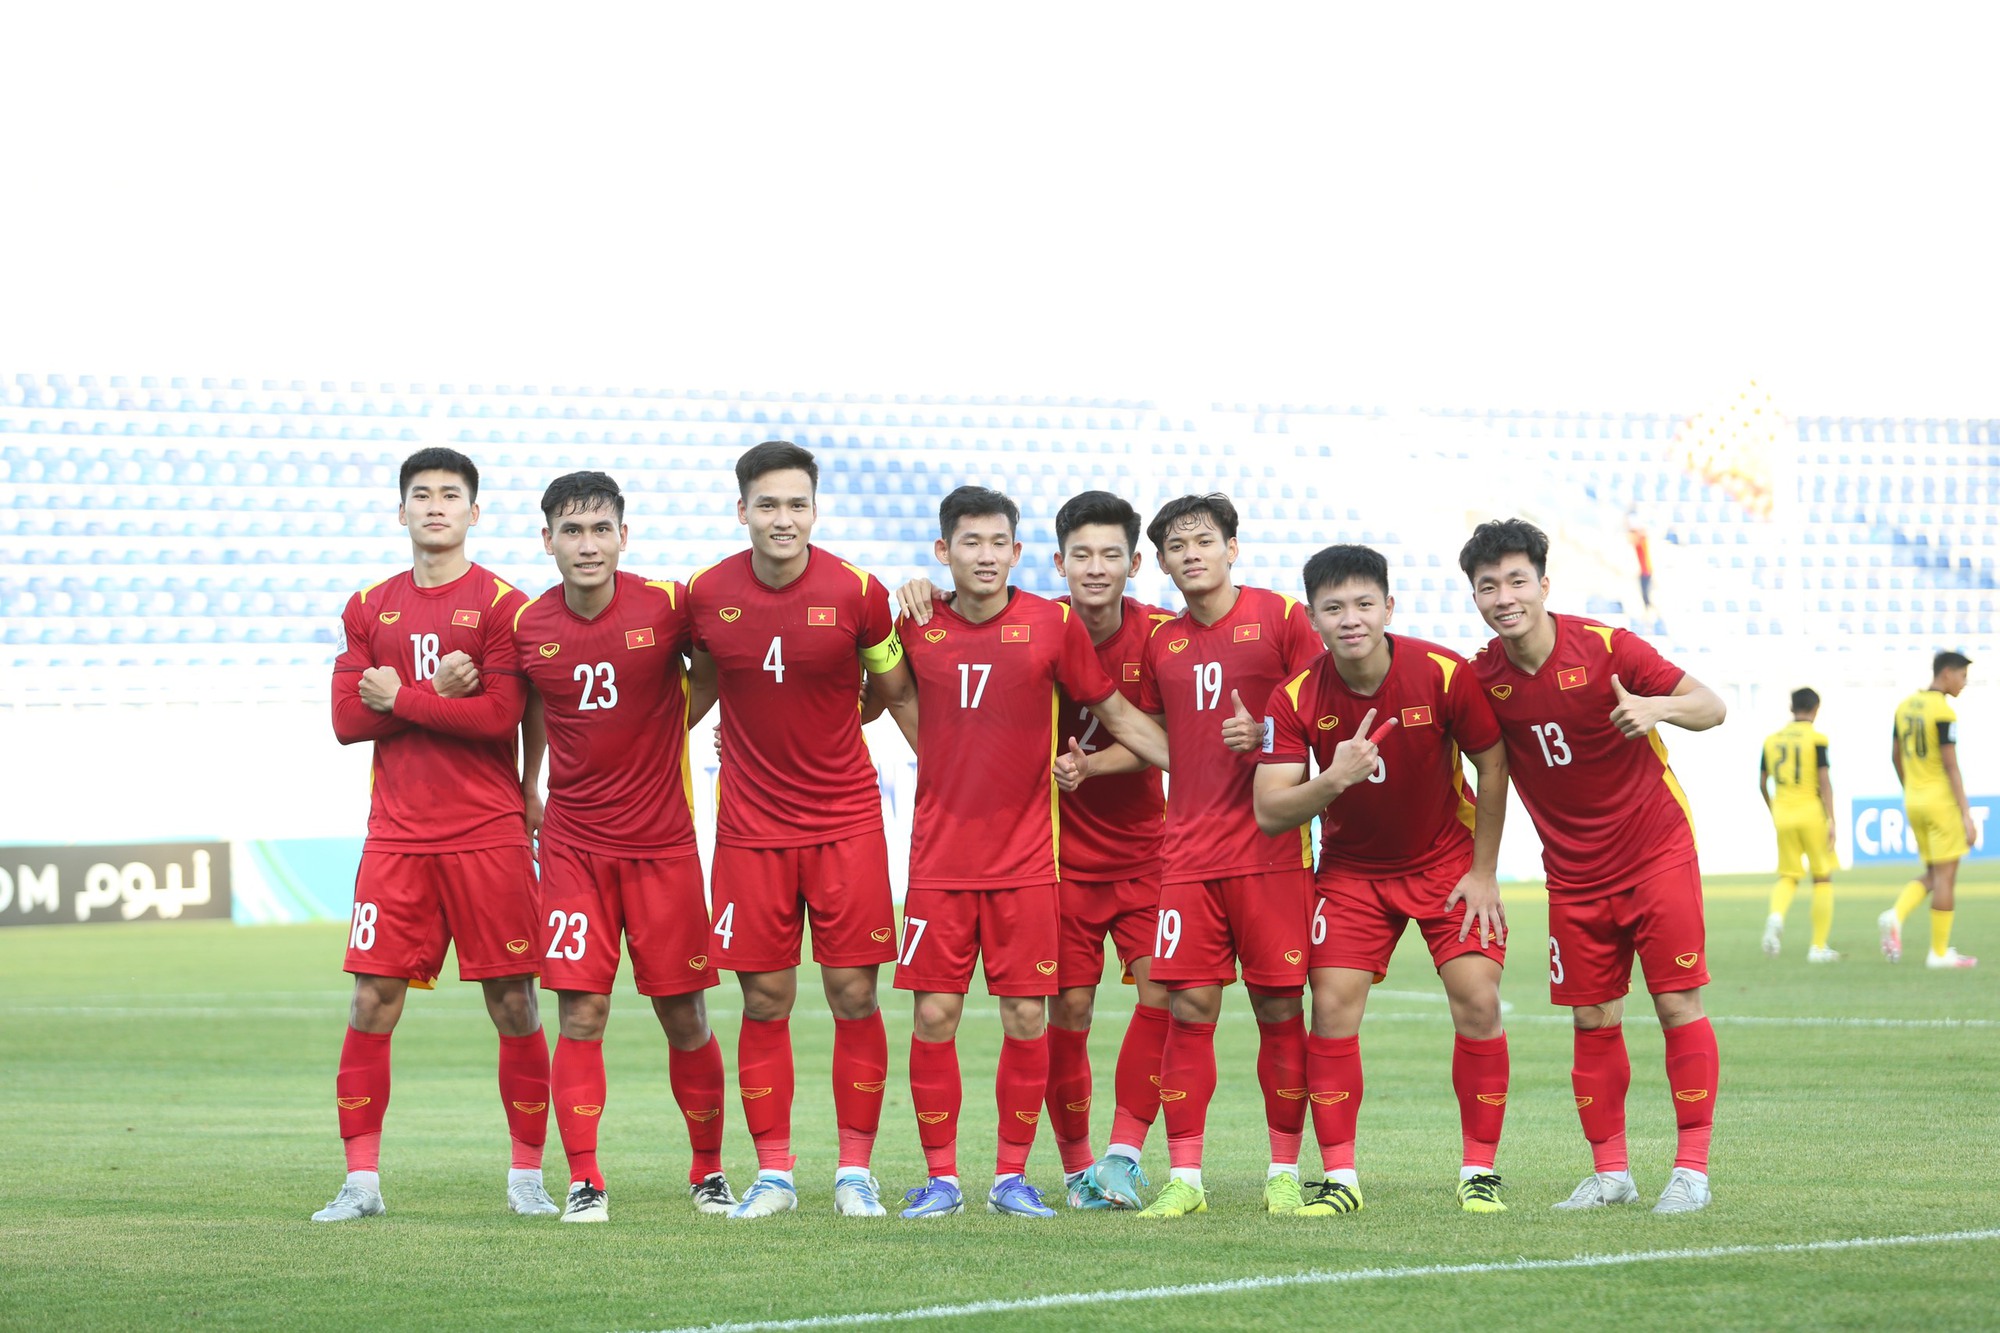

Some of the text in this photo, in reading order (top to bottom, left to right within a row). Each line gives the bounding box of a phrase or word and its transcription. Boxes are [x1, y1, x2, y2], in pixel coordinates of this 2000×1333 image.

[410, 633, 440, 681] 18
[763, 636, 785, 683] 4
[573, 661, 618, 711] 23
[957, 663, 992, 709] 17
[1193, 661, 1222, 711] 19
[1078, 706, 1099, 751] 2
[1530, 722, 1572, 767] 13
[1902, 713, 1928, 759] 20
[1774, 743, 1802, 785] 21
[350, 902, 378, 951] 18
[546, 910, 588, 961] 23
[713, 902, 735, 949] 4
[897, 915, 928, 966] 17
[1154, 909, 1182, 959] 19
[1311, 897, 1327, 945] 6
[1549, 936, 1564, 984] 3
